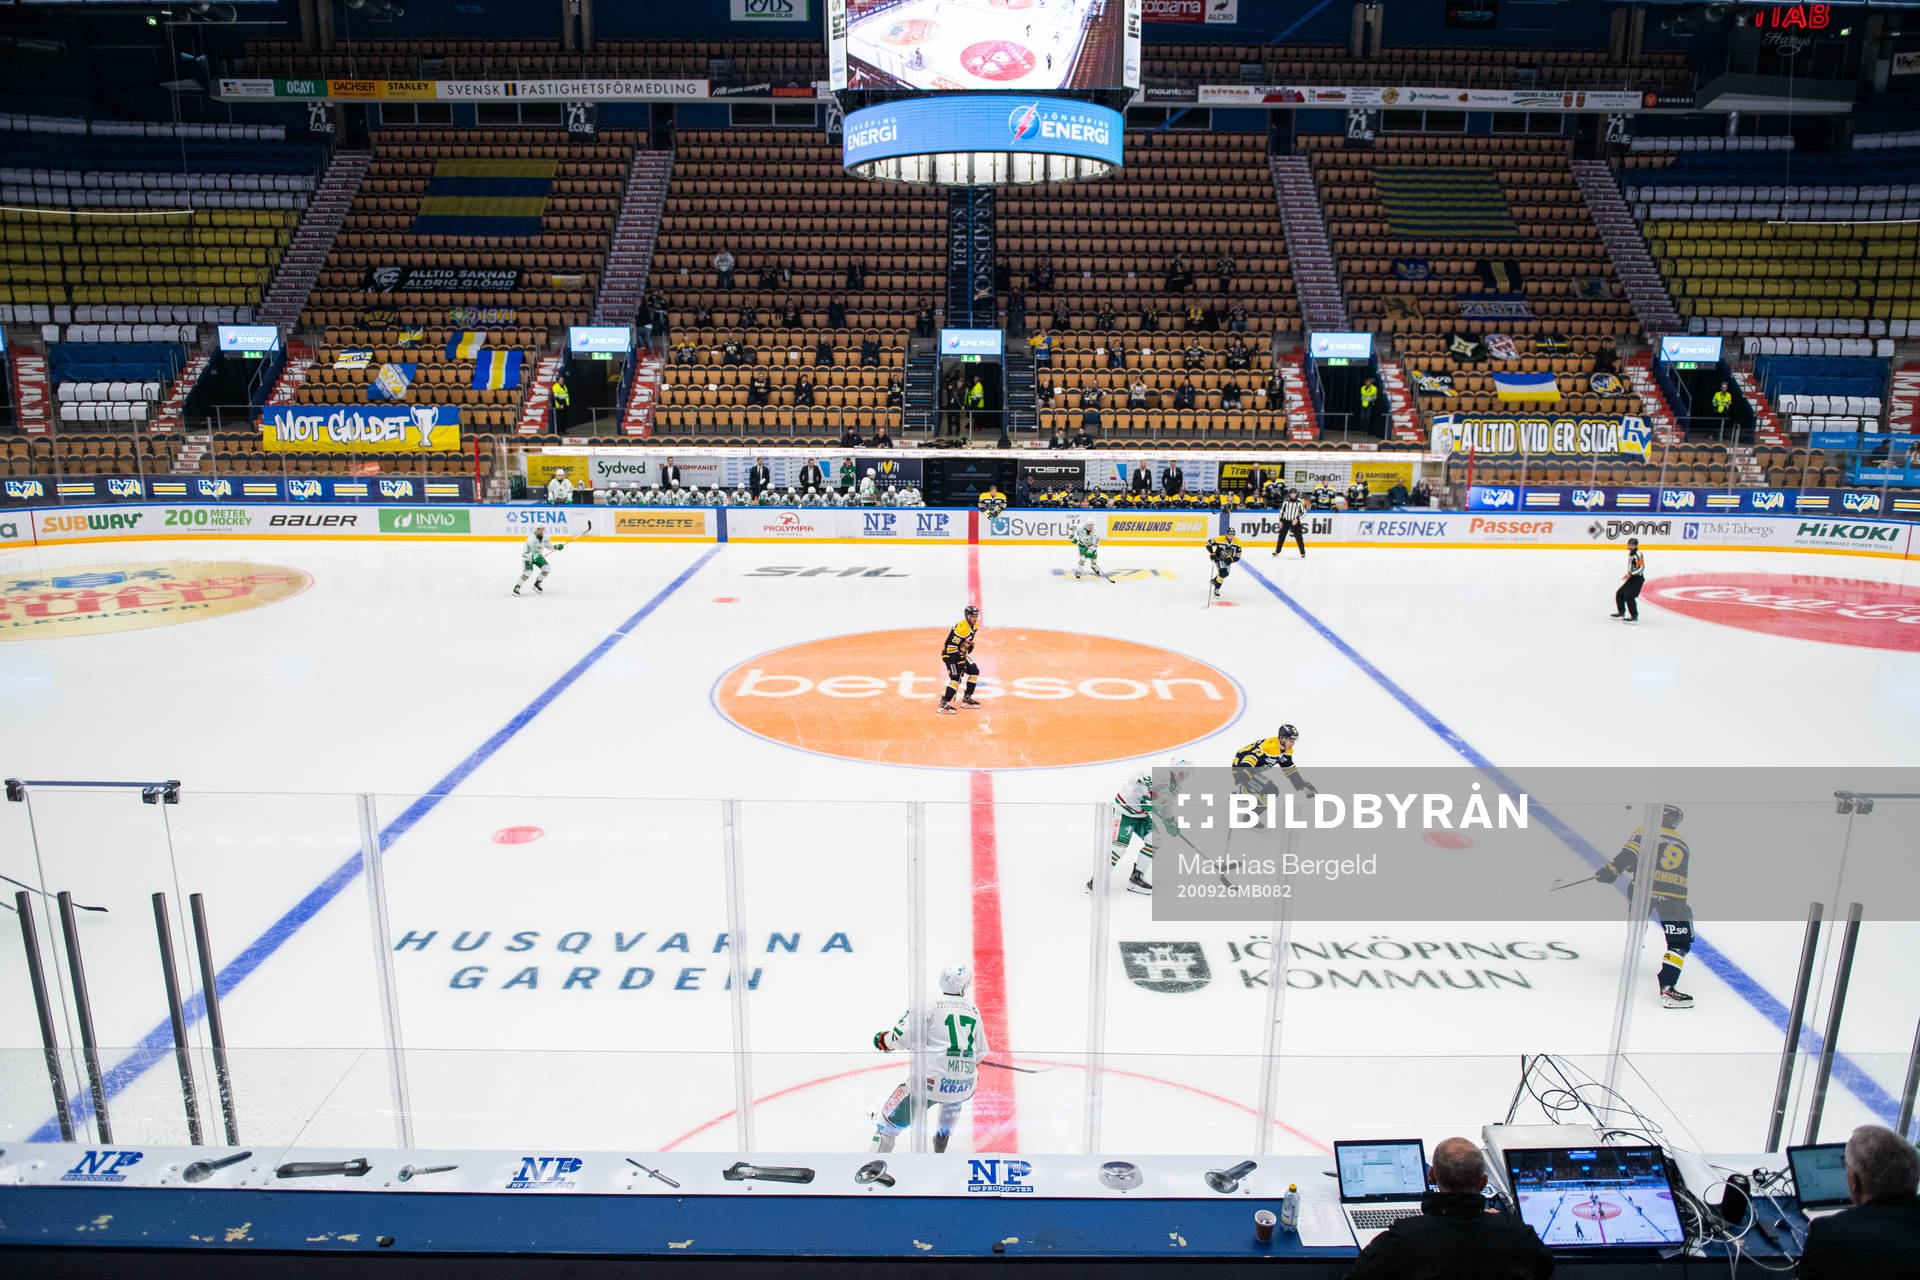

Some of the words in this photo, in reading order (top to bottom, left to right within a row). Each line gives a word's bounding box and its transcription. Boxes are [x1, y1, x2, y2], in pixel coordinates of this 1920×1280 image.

[1207, 13, 1233, 21] ALCRO
[287, 80, 315, 94] OCAY!
[334, 81, 375, 91] DACHSER
[388, 82, 429, 91] STANLEY
[447, 84, 500, 96] SVENSK
[521, 81, 697, 96] FASTIGHETSFÖRMEDLING
[847, 124, 897, 151] ENERGI
[1041, 120, 1109, 146] ENERGI
[408, 269, 454, 279] ALLTID
[457, 270, 517, 279] SAKNAD
[405, 279, 457, 288] ALDRIG
[461, 278, 514, 288] GLÖMD
[274, 409, 324, 442] MOT
[327, 409, 410, 444] GULDET
[1461, 422, 1515, 453] ALLTID
[1520, 422, 1548, 453] VID
[1553, 422, 1575, 452] ER
[1579, 422, 1619, 453] SIDA
[598, 463, 646, 478] Sydved
[1024, 466, 1079, 474] TOSITO
[41, 512, 143, 534] SUBWAY
[165, 509, 208, 526] 200
[210, 509, 246, 518] METER
[211, 517, 252, 526] HOCKEY
[520, 511, 567, 524] STENA
[864, 513, 896, 531] NP
[916, 513, 949, 531] NP
[1469, 517, 1554, 534] Passera
[1011, 518, 1079, 538] Sveru
[1112, 521, 1173, 532] ROSENLUNDS
[1311, 518, 1331, 535] bil
[1376, 521, 1448, 537] RESINEX
[1702, 522, 1730, 534] TMG
[1732, 523, 1774, 538] Tabergs
[741, 566, 911, 578] SHL
[1661, 844, 1684, 870] 9
[1663, 924, 1688, 935] JP.se
[393, 930, 853, 955] HUSQVARNA
[1227, 935, 1580, 962] JÖNKÖPINGS
[449, 965, 763, 991] GARDEN
[1240, 969, 1533, 990] KOMMUN
[944, 1013, 977, 1058] 17
[68, 1150, 144, 1174] NP
[512, 1157, 583, 1181] NP
[967, 1159, 1032, 1185] NP
